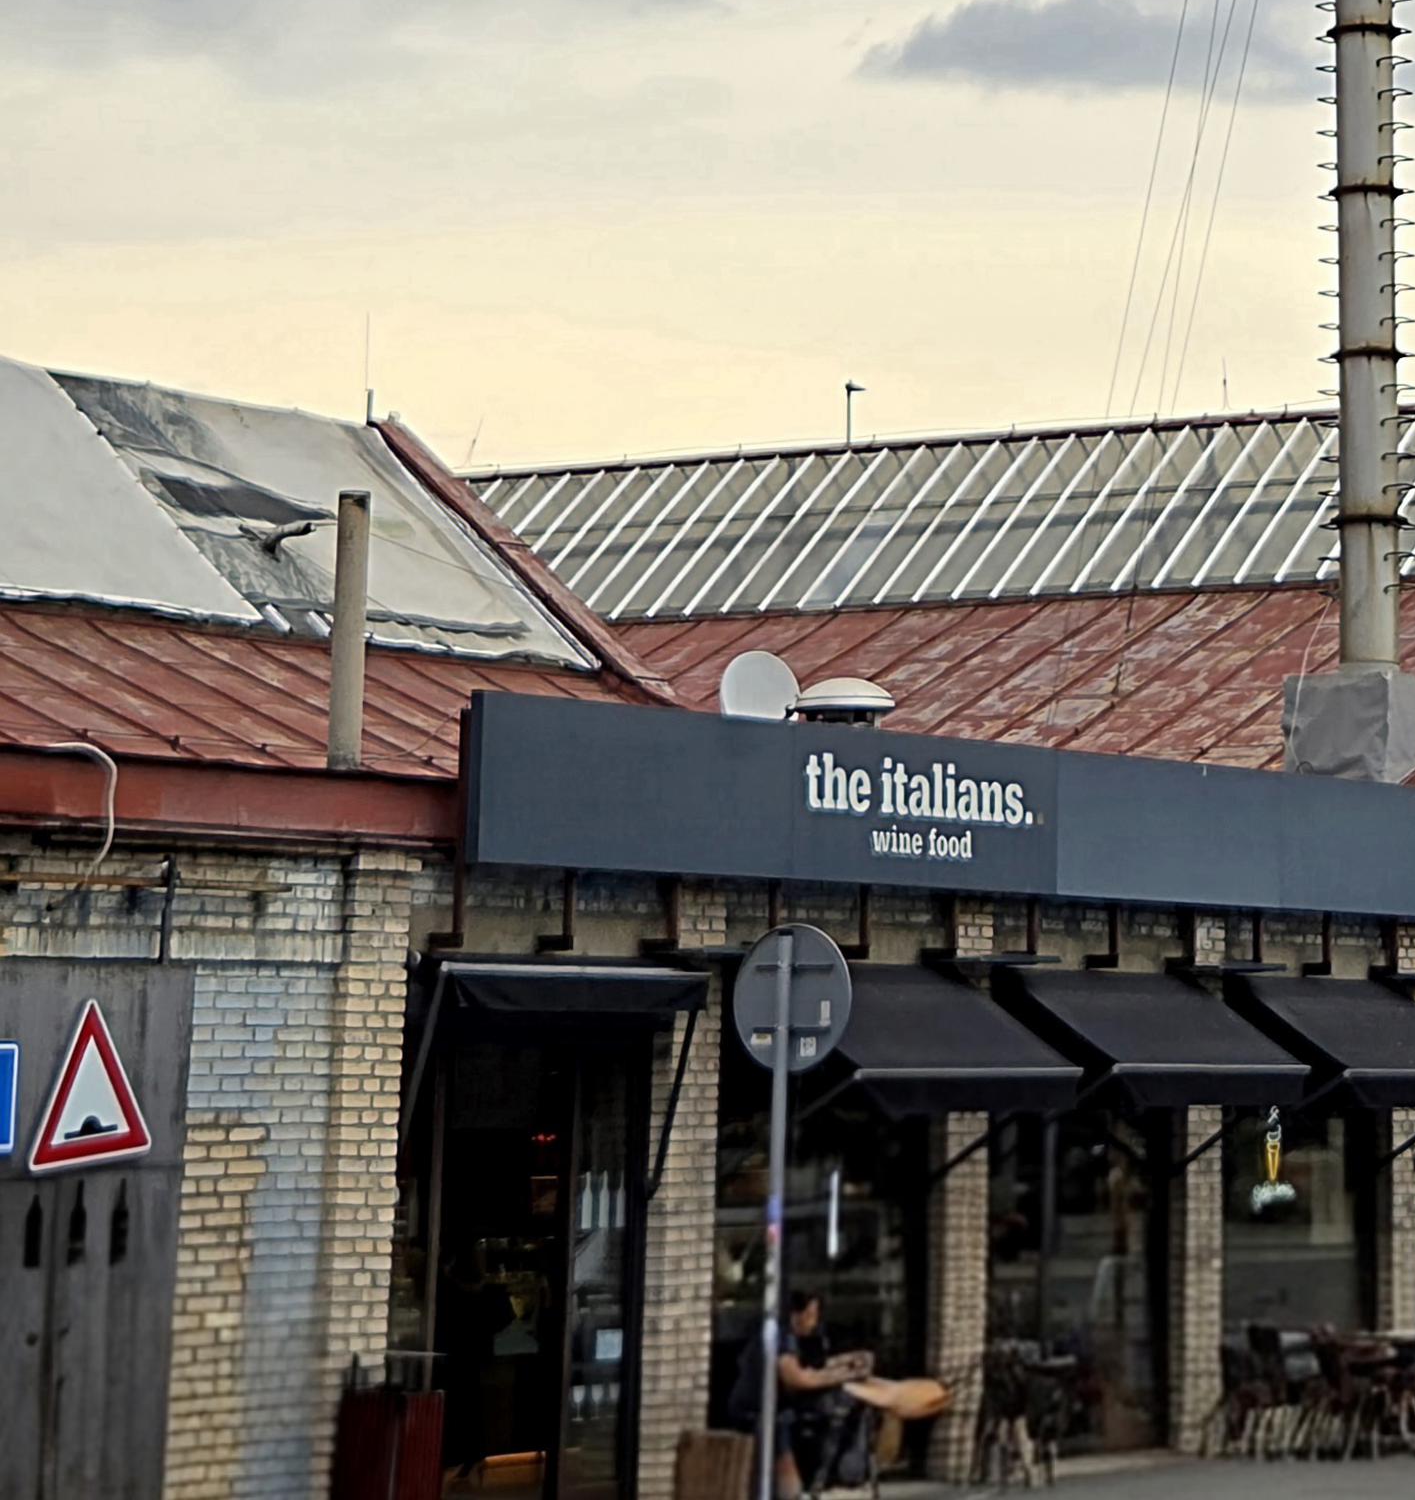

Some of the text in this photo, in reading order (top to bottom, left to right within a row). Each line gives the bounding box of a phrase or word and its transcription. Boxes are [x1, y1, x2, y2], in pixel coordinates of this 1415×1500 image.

[806, 752, 1034, 826] the italians.
[872, 825, 973, 859] wine food
